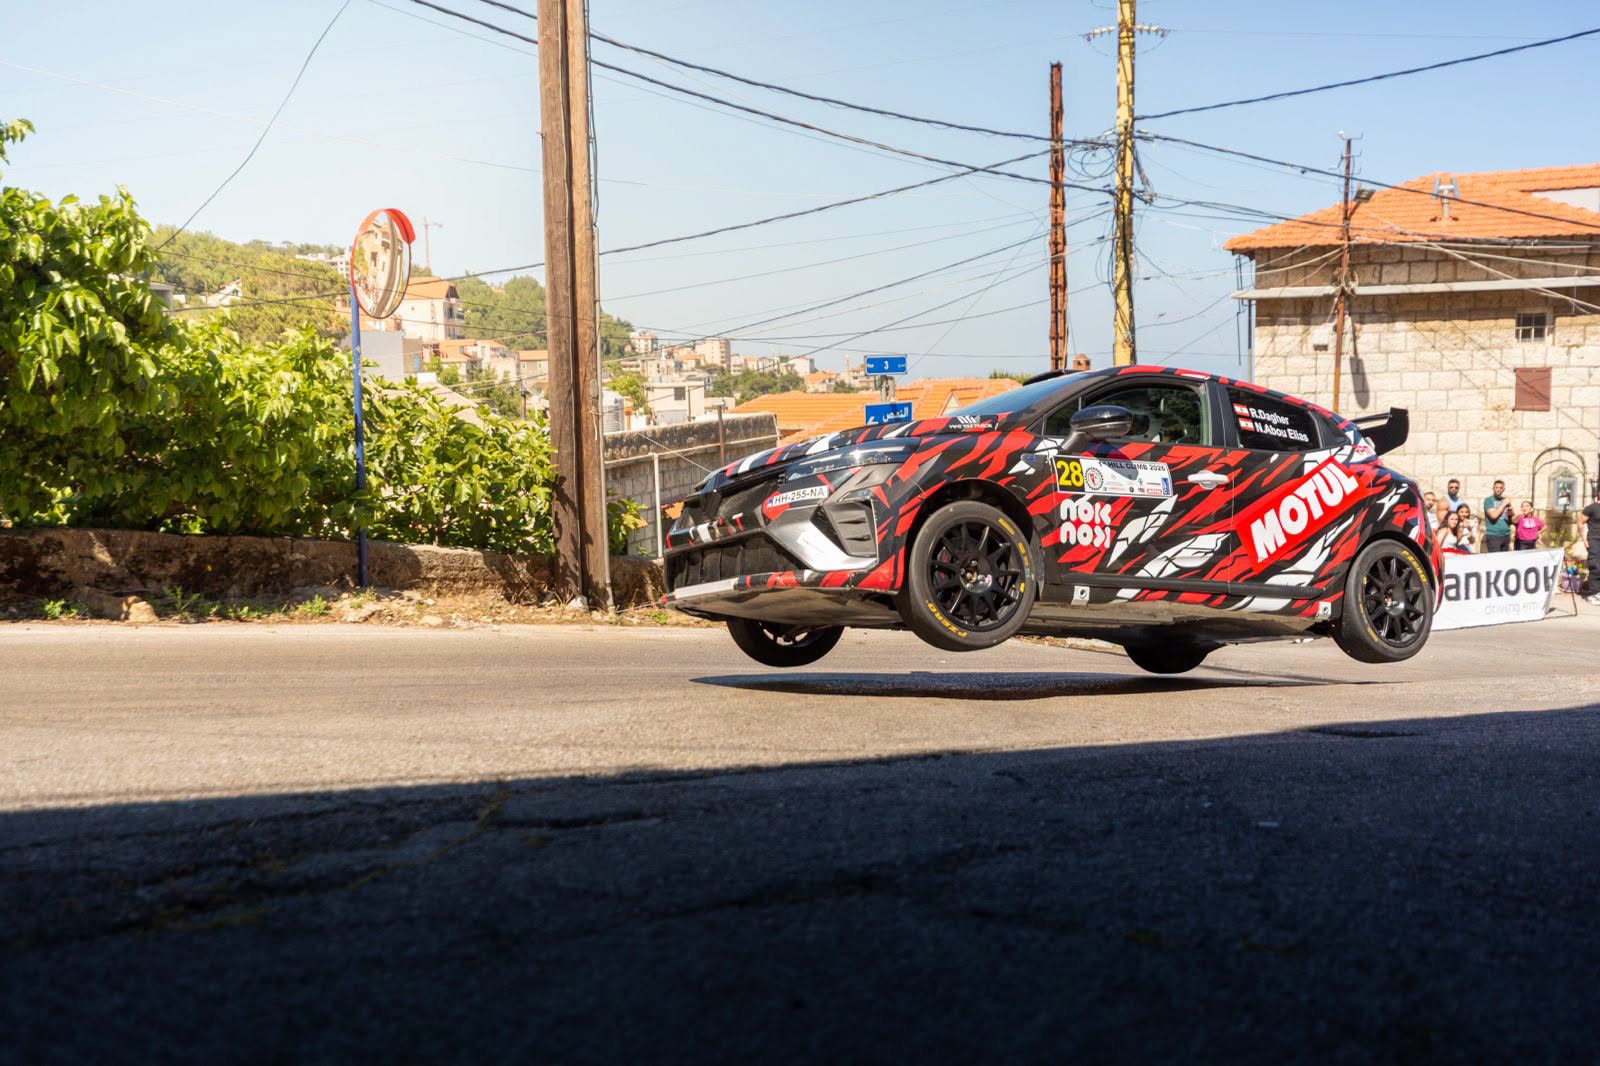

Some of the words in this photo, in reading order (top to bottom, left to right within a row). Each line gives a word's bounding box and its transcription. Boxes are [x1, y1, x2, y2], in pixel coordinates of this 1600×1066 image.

[884, 360, 889, 370] 3
[1249, 407, 1290, 425] R.Dagher
[1254, 421, 1288, 438] N.Abou
[1287, 428, 1309, 442] Elias
[1056, 460, 1084, 487] 28
[774, 487, 825, 504] HH-255-NA
[1250, 463, 1359, 563] MOTUL
